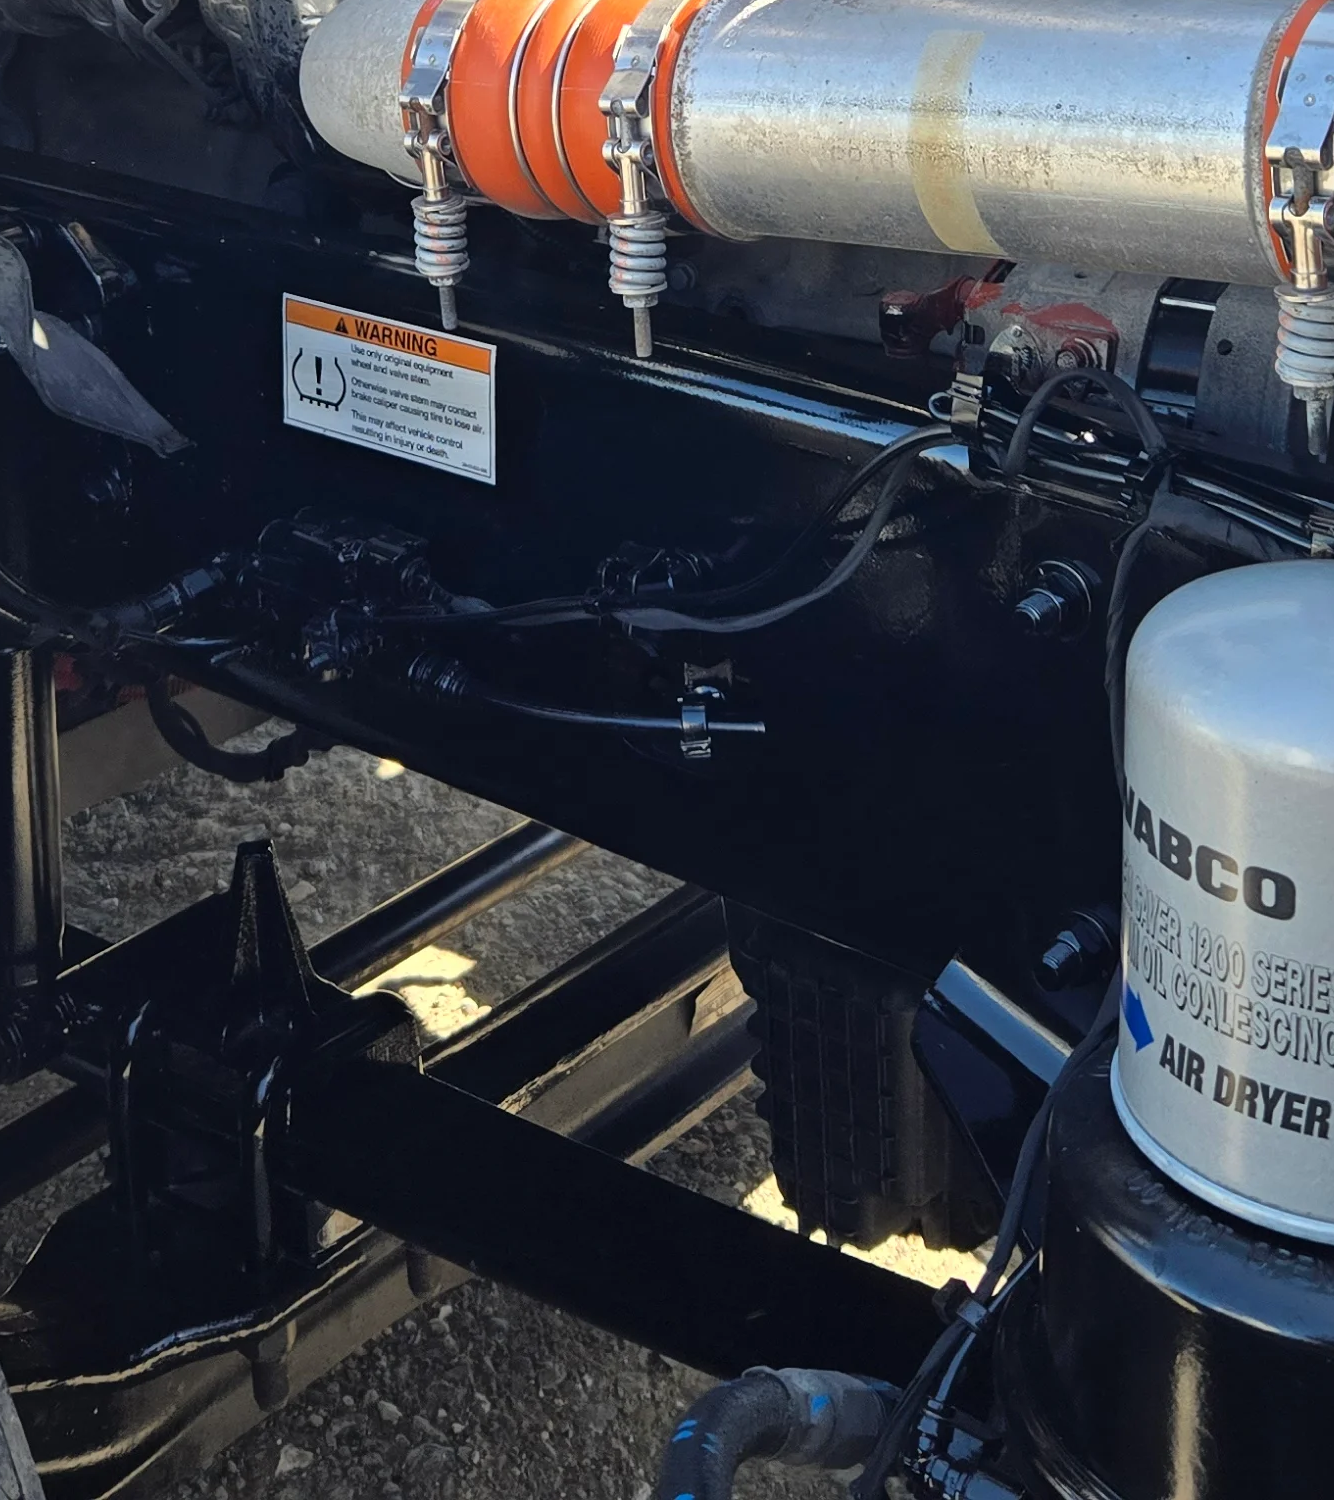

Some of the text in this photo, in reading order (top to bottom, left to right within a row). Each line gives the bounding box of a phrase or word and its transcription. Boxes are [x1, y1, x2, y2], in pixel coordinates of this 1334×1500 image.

[354, 319, 438, 357] WARNING
[351, 343, 454, 379] Use only original equipment
[351, 358, 371, 371] wheel
[373, 363, 387, 375] and
[389, 367, 409, 380] valve
[351, 377, 477, 420] Otherwise valve stem may contact
[351, 389, 371, 403] brake
[373, 394, 398, 411] caliper
[399, 402, 428, 420] causing
[430, 410, 443, 422] tire
[444, 414, 453, 424] to
[454, 416, 471, 429] lose
[351, 409, 463, 450] This may affect vehicle control
[352, 424, 383, 441] resulting
[384, 432, 392, 442] in
[393, 434, 415, 451] injury
[416, 441, 425, 451] or
[1142, 935, 1167, 1000] OIL
[1188, 921, 1245, 989] 1200
[1159, 1033, 1332, 1140] AIR DRYER
